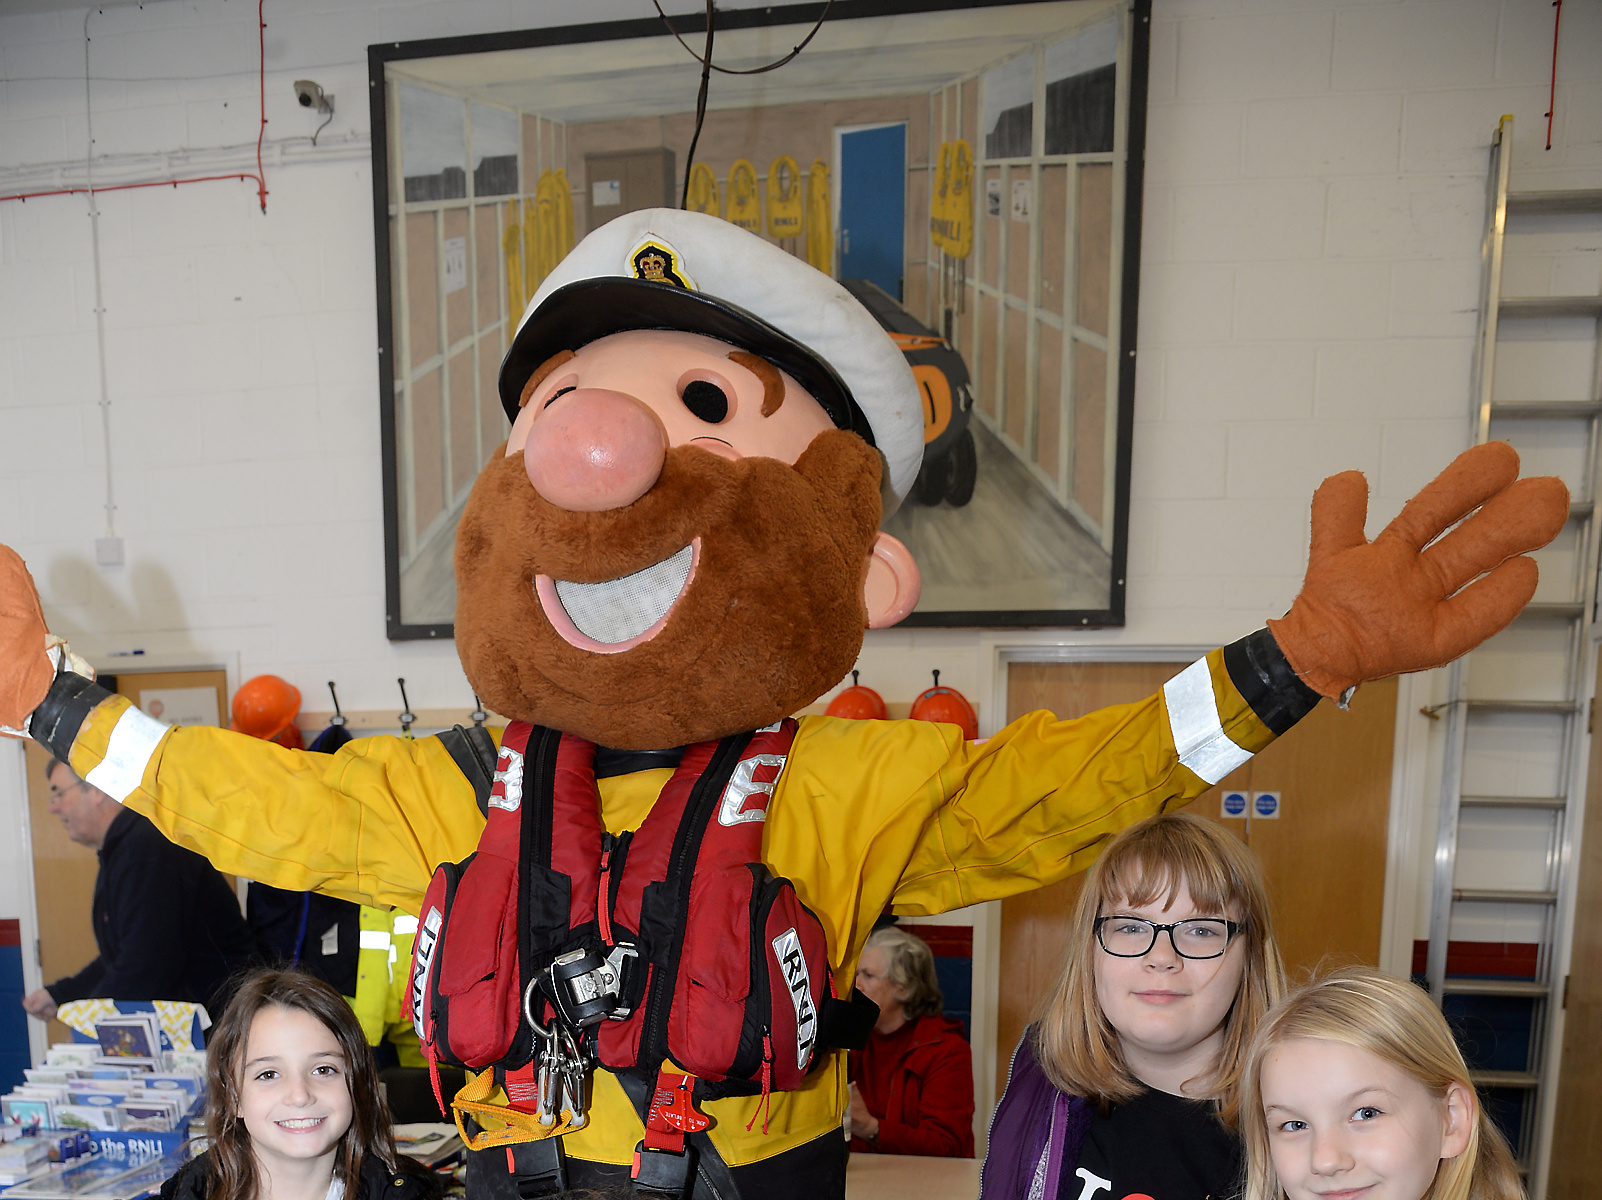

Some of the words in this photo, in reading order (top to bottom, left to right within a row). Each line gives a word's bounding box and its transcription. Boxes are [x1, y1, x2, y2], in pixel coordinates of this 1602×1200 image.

[412, 924, 437, 1023] RNLI
[783, 948, 814, 1051] RNLI
[101, 1137, 126, 1153] the
[128, 1138, 163, 1155] RNLI
